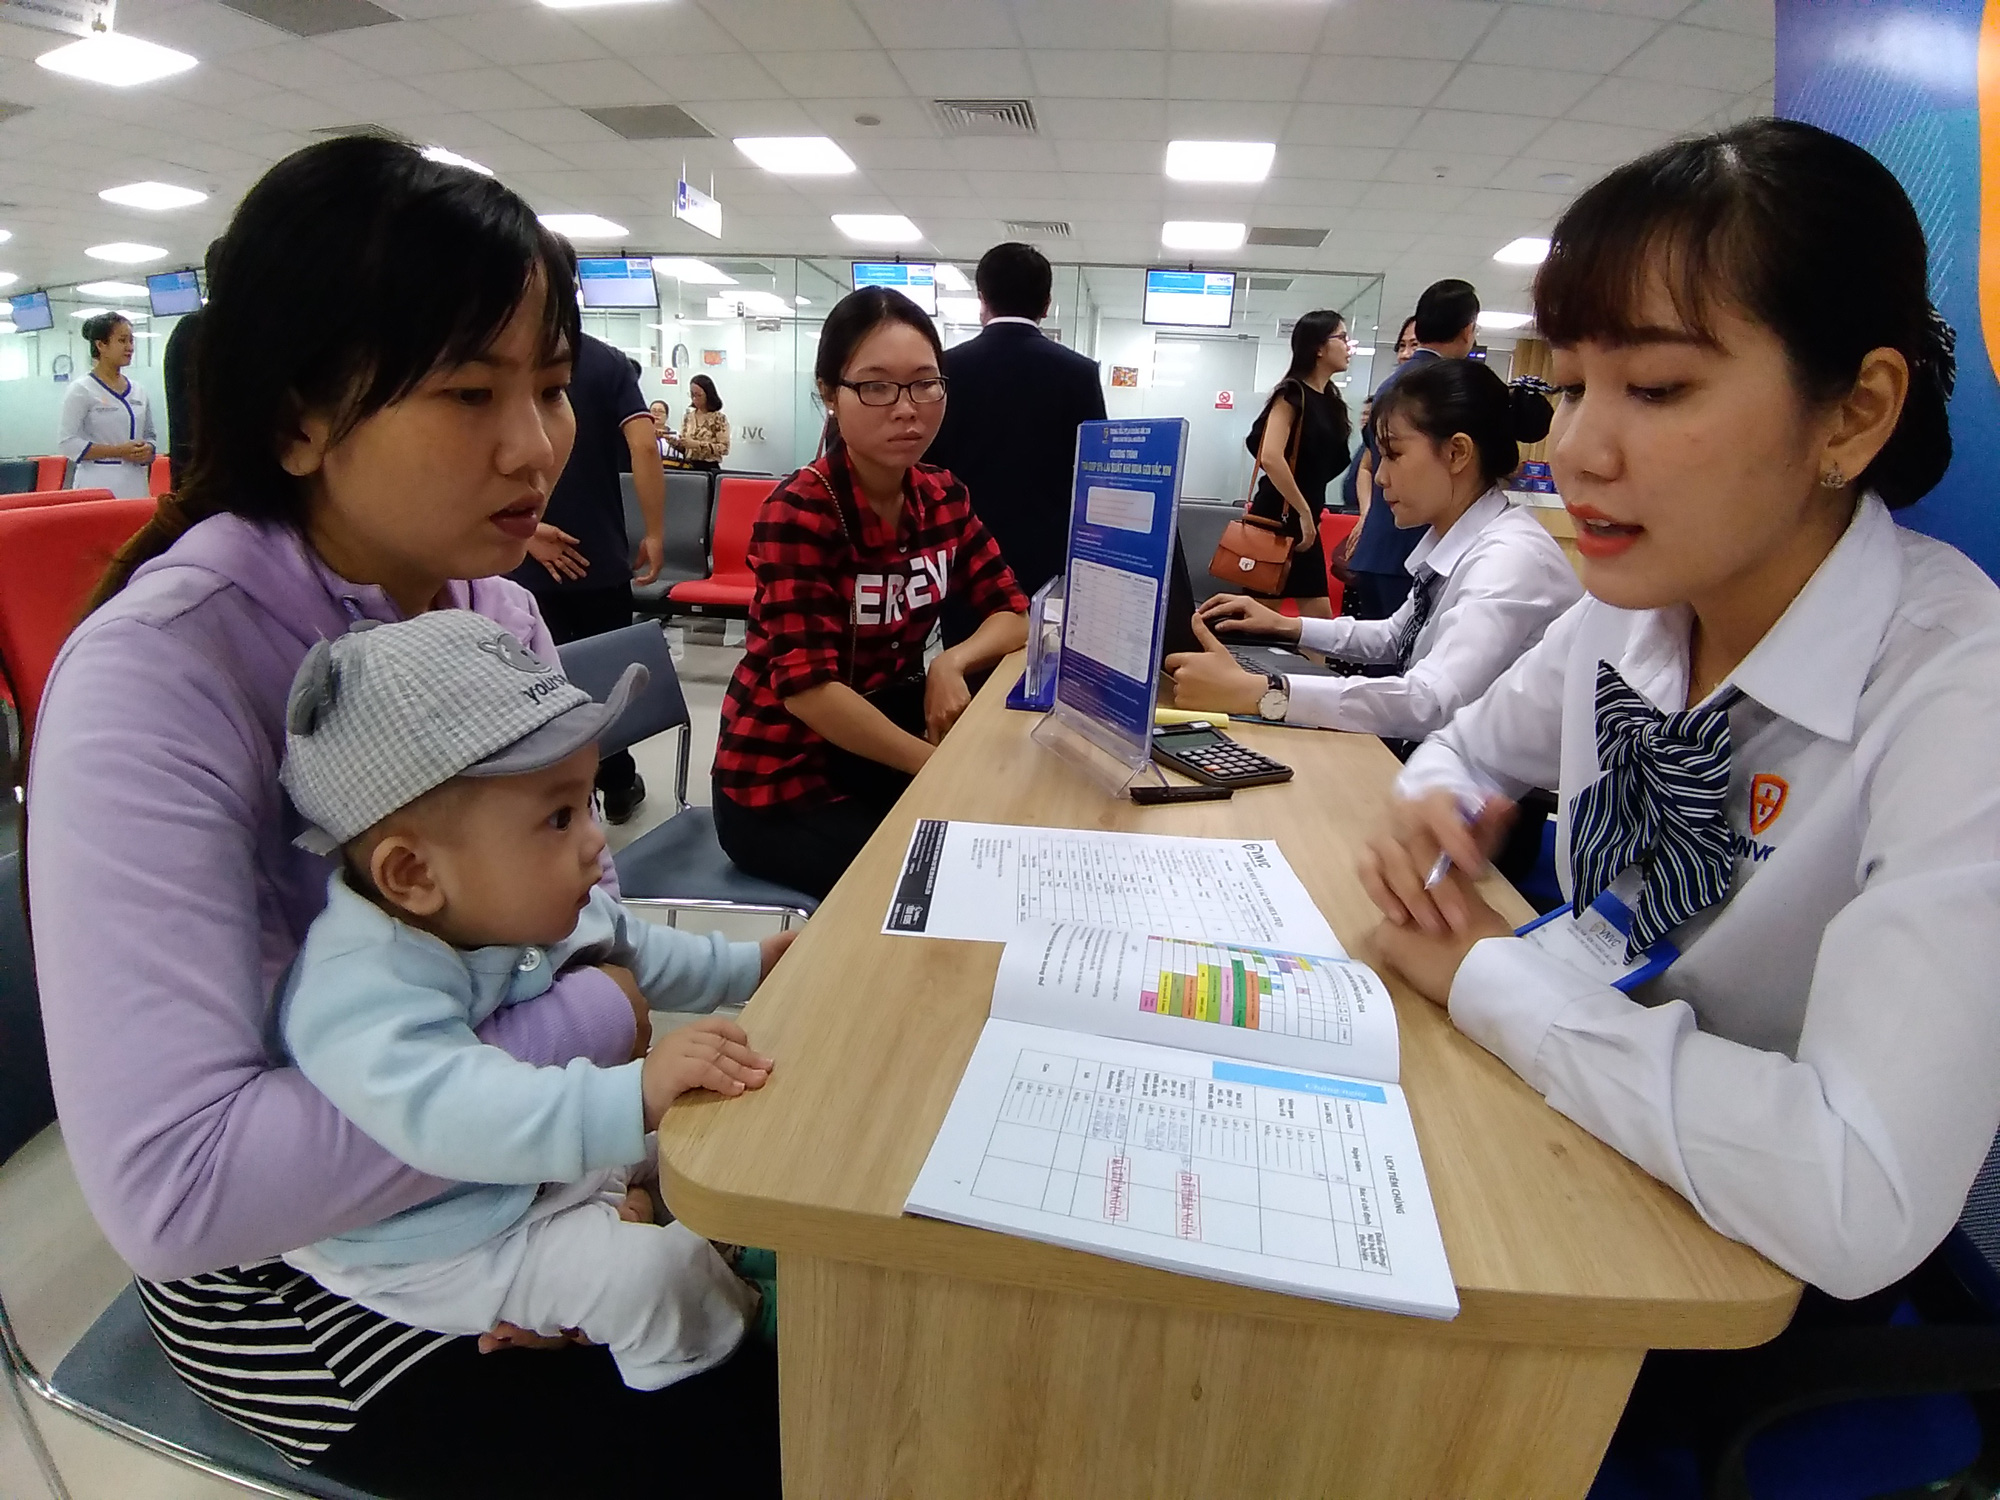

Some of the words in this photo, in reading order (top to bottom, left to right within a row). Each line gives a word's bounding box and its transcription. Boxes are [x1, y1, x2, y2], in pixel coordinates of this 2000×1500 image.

[1599, 928, 1621, 947] VNVC
[1384, 1155, 1396, 1170] LỊCH
[1387, 1171, 1400, 1188] TIÊM
